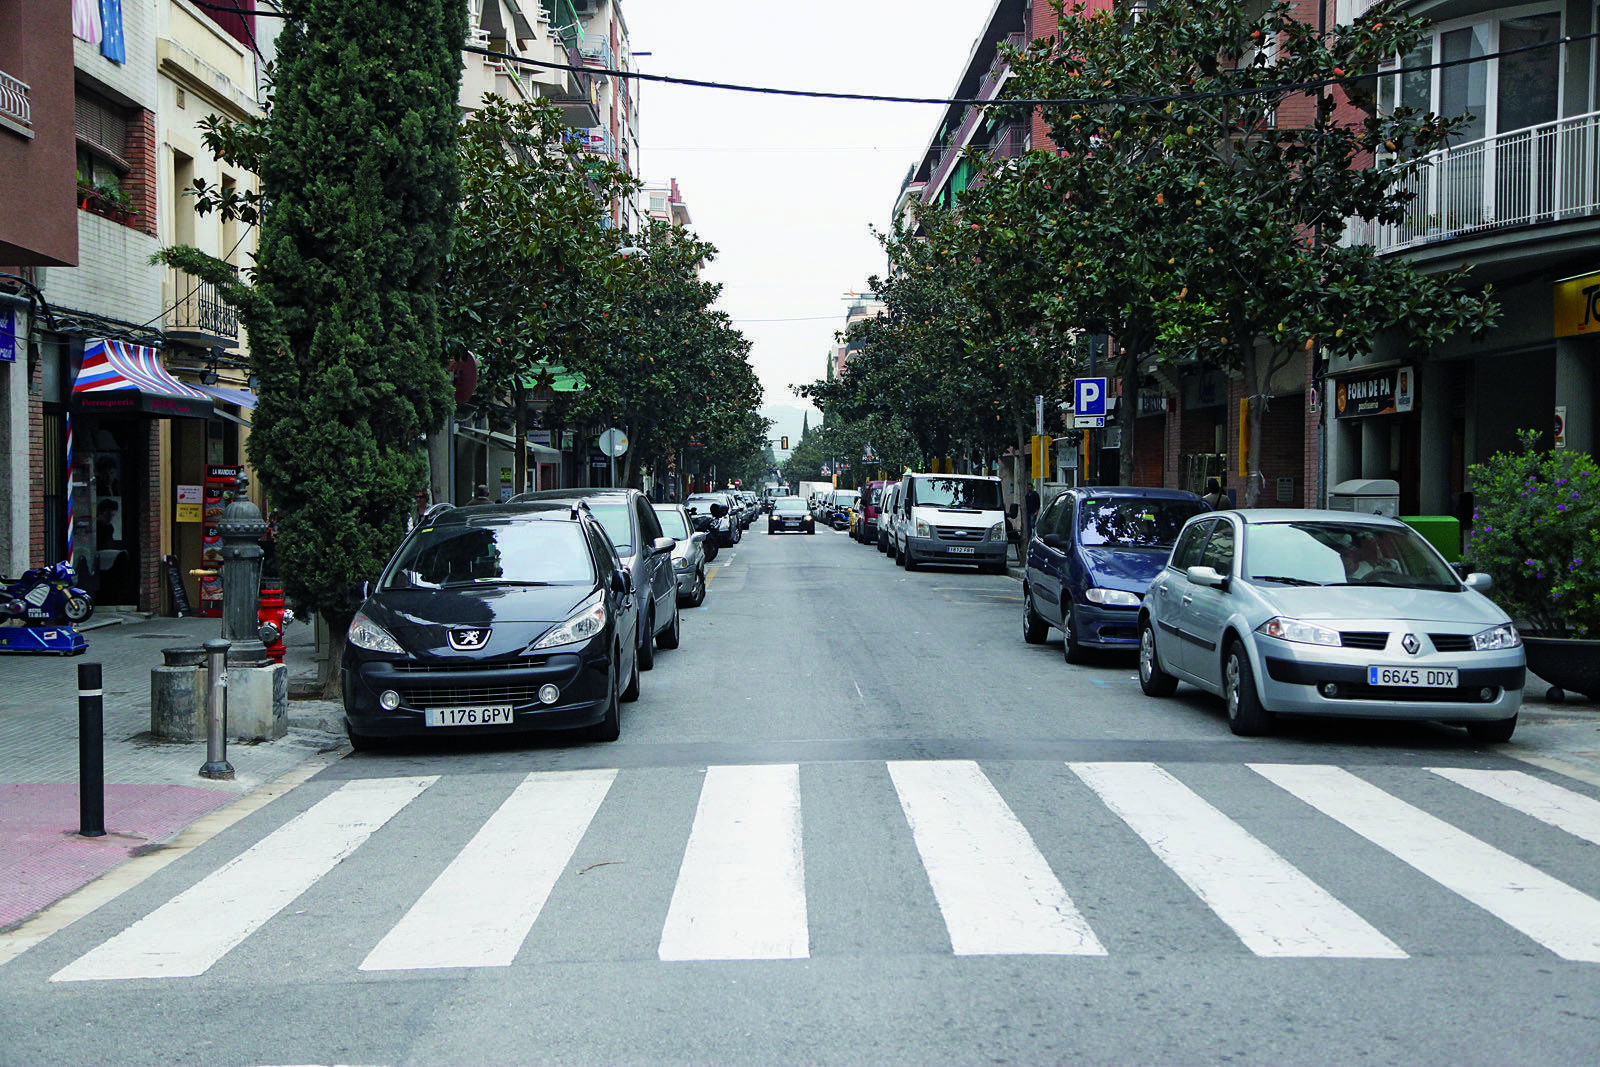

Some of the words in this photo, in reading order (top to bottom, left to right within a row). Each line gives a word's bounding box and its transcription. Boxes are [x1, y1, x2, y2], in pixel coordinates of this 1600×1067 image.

[1081, 383, 1099, 411] P
[1347, 381, 1367, 400] FORN
[1368, 380, 1378, 397] DE
[1380, 378, 1391, 395] PA
[82, 398, 134, 408] Perruqueria
[212, 468, 218, 476] LA
[1382, 669, 1420, 684] 6645
[1426, 670, 1454, 686] DDX
[439, 709, 478, 724] 1176
[481, 707, 511, 723] GPV
